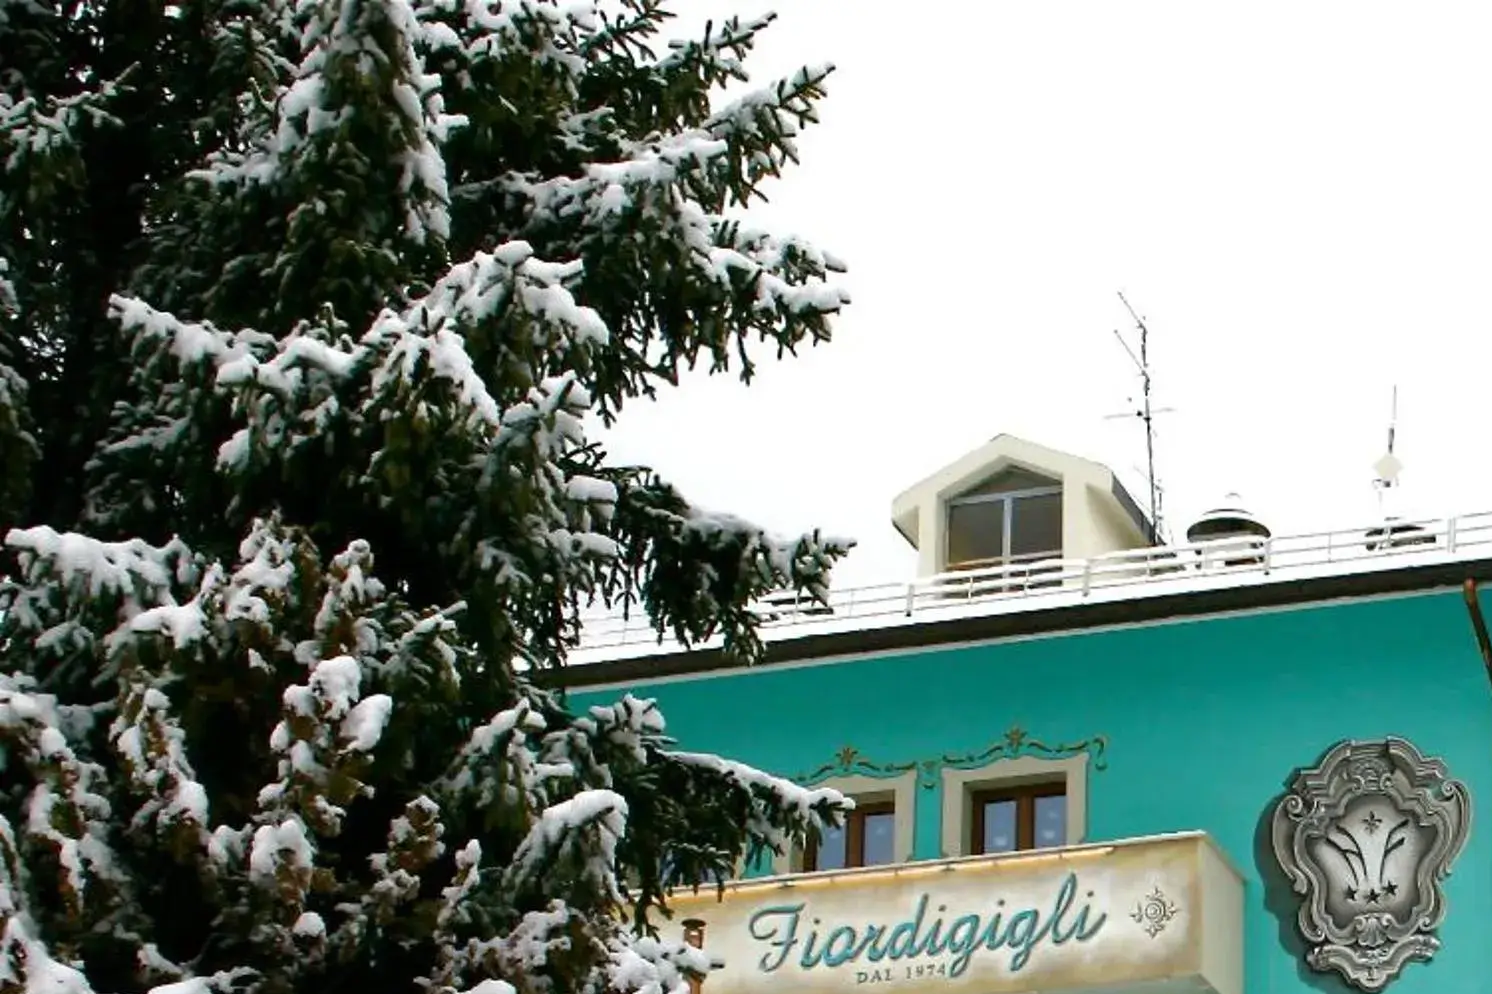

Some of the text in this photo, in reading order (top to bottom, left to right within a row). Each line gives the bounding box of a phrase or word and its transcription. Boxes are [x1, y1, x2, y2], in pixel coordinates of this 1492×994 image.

[748, 871, 1107, 977] Fiordigigli
[856, 963, 946, 984] DAL 1974
